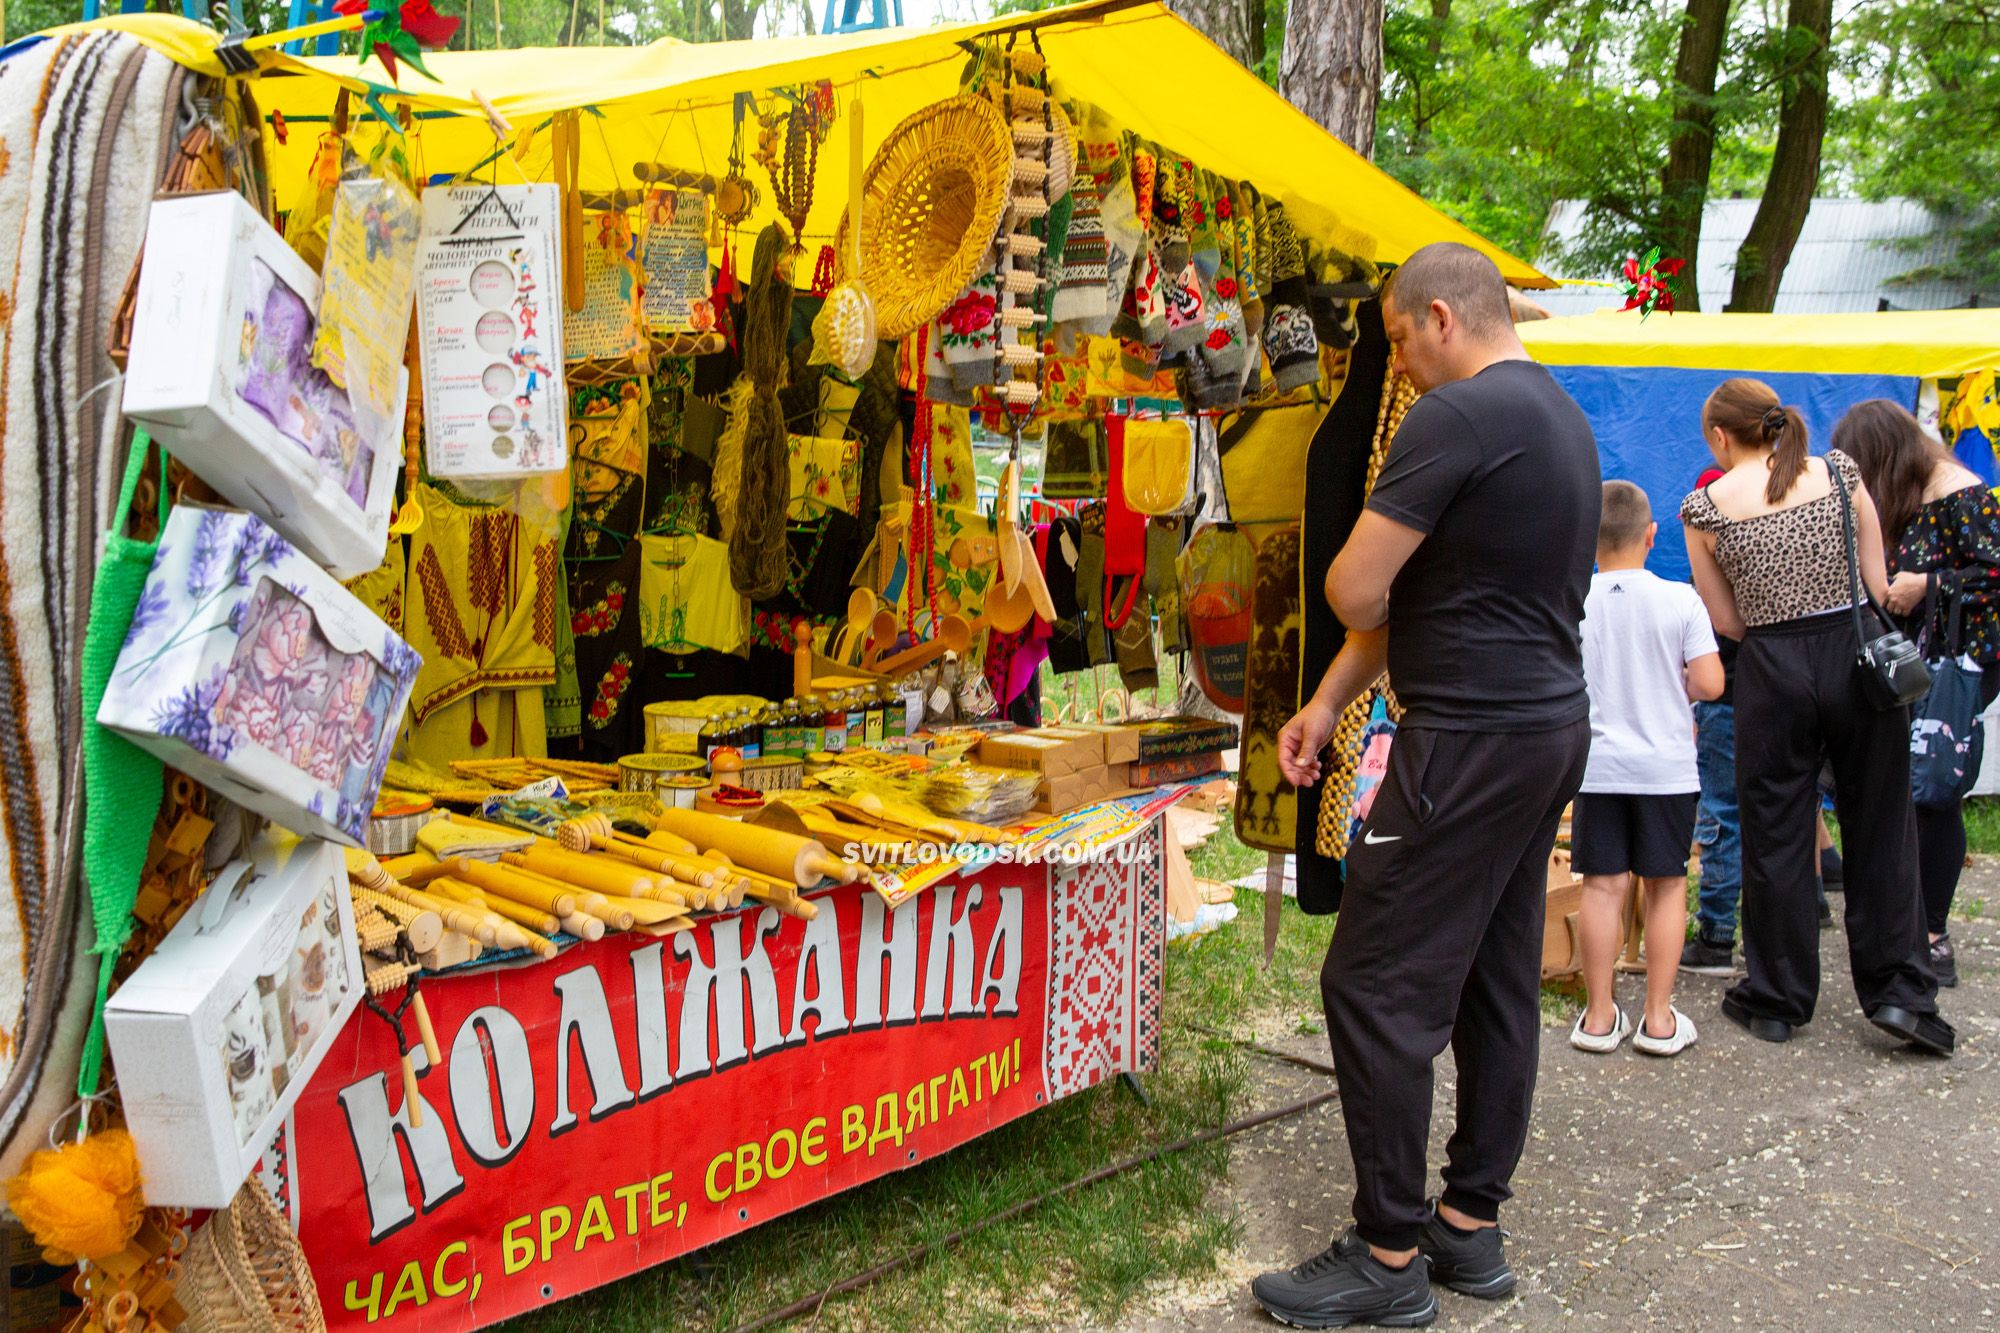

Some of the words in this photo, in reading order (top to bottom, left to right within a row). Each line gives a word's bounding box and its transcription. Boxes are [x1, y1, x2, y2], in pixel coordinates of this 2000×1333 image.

[427, 248, 502, 261] ЧОЛОВІЧОГО
[459, 199, 525, 215] ЖНОЧОЇ
[337, 885, 1024, 1245] КОЛІЖАНКА
[343, 1241, 483, 1322] ЧАС,
[502, 1172, 688, 1276] БРАТЕ,
[704, 1116, 828, 1203] СВОЄ
[841, 1039, 1023, 1160] ВДЯГАТИ!
